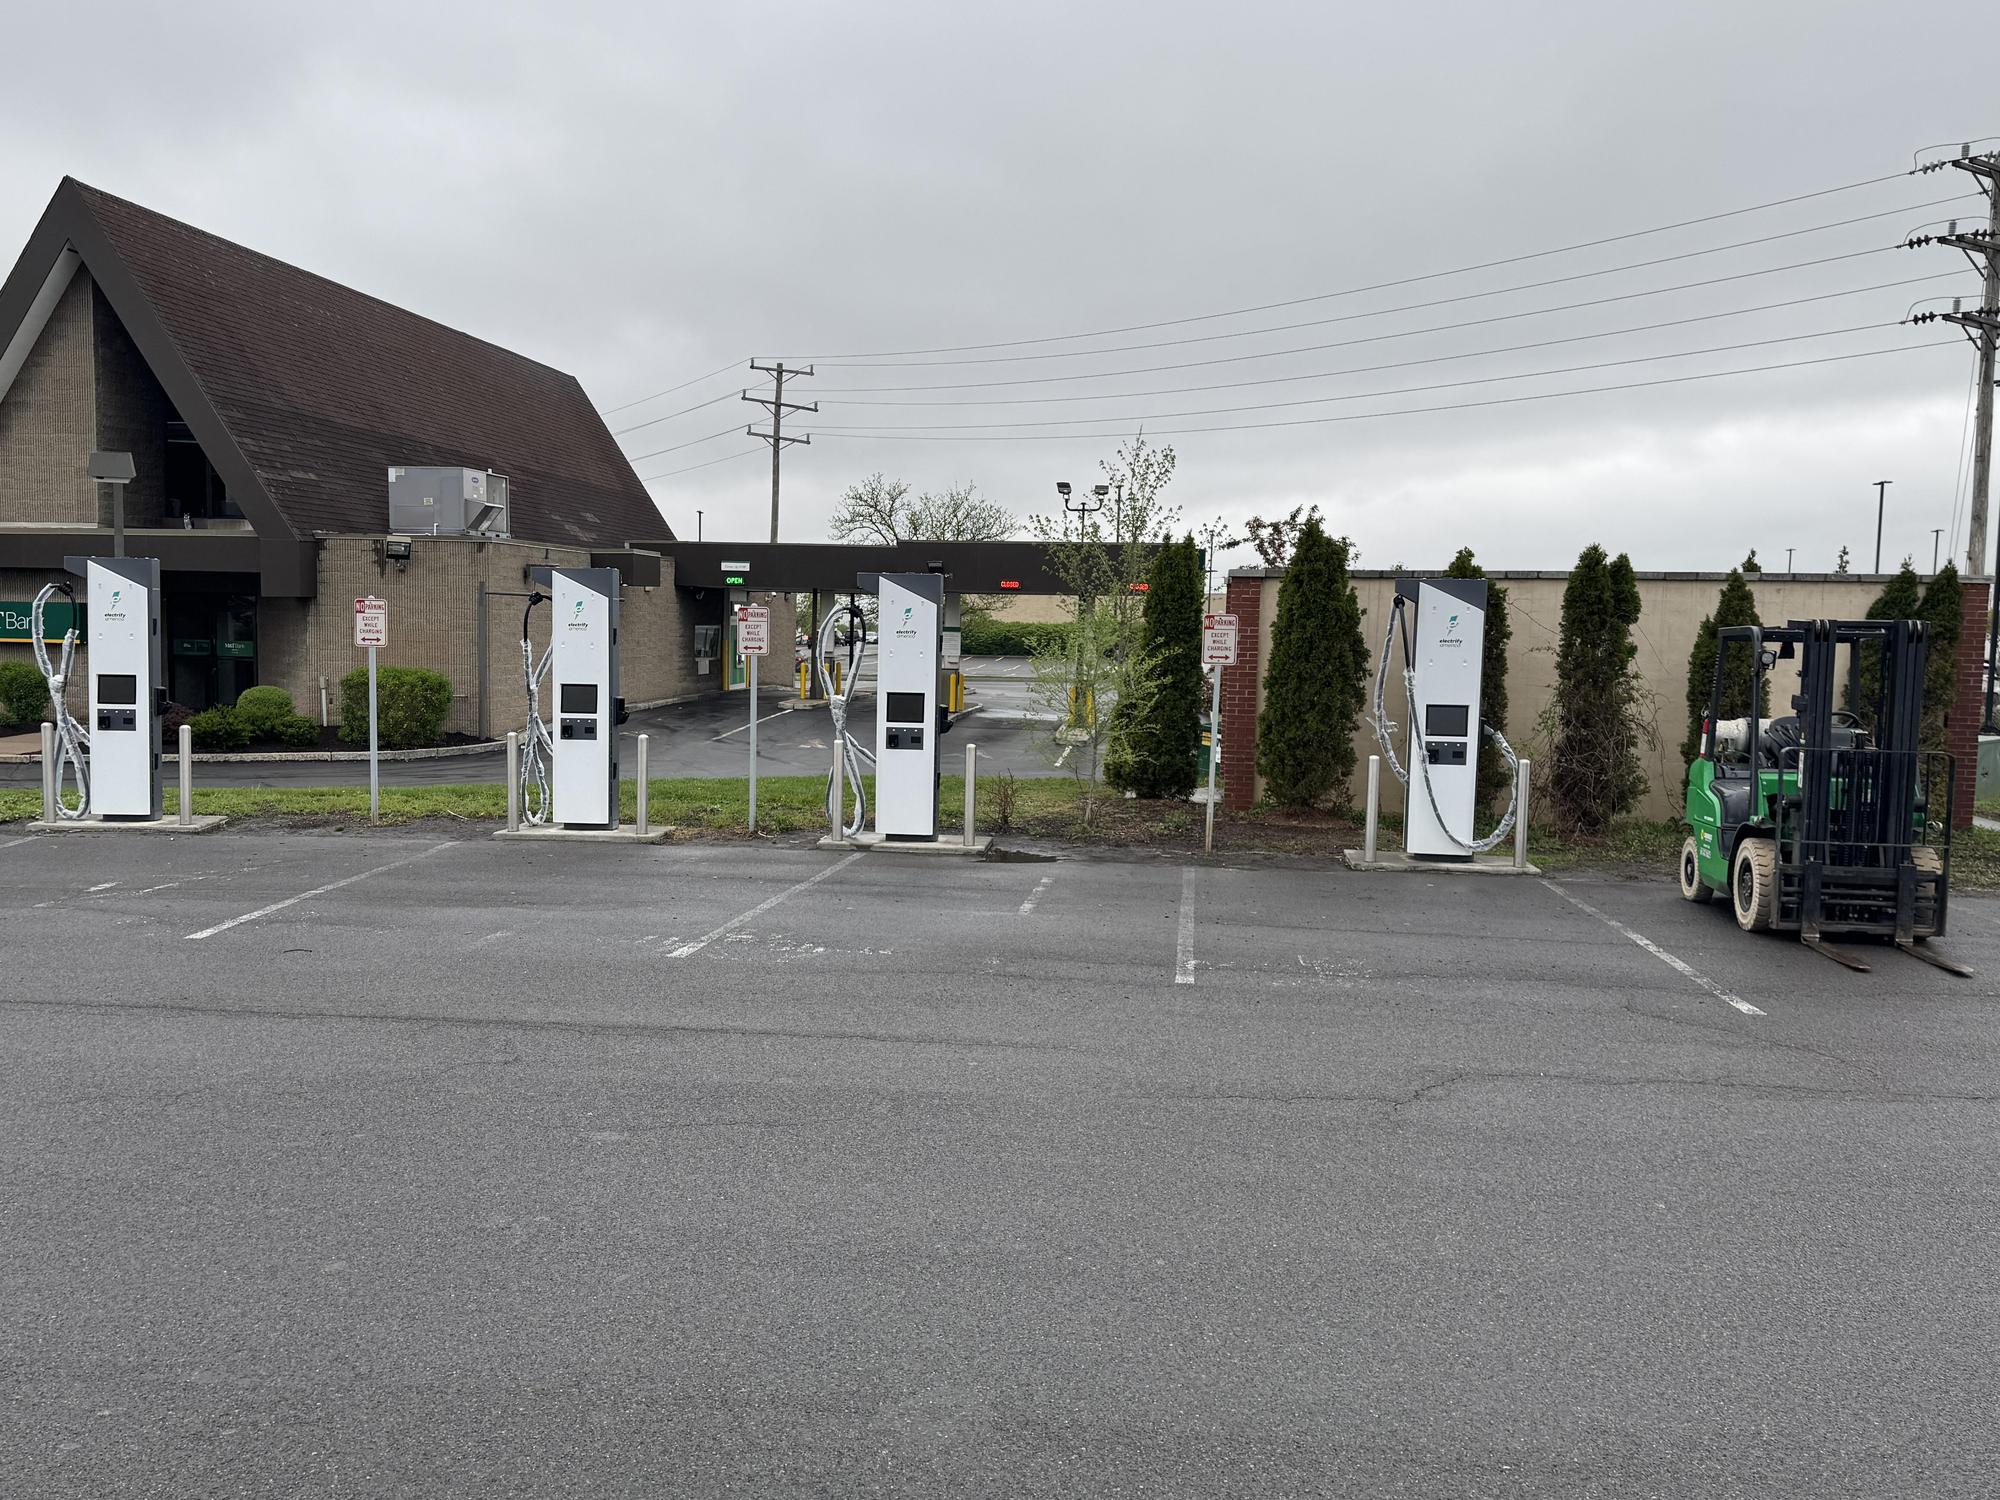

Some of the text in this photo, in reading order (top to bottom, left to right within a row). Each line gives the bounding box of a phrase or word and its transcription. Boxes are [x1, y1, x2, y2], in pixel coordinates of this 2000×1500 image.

[355, 601, 365, 612] NO
[739, 609, 767, 620] NO PARKING
[1205, 617, 1236, 629] NO PARKING
